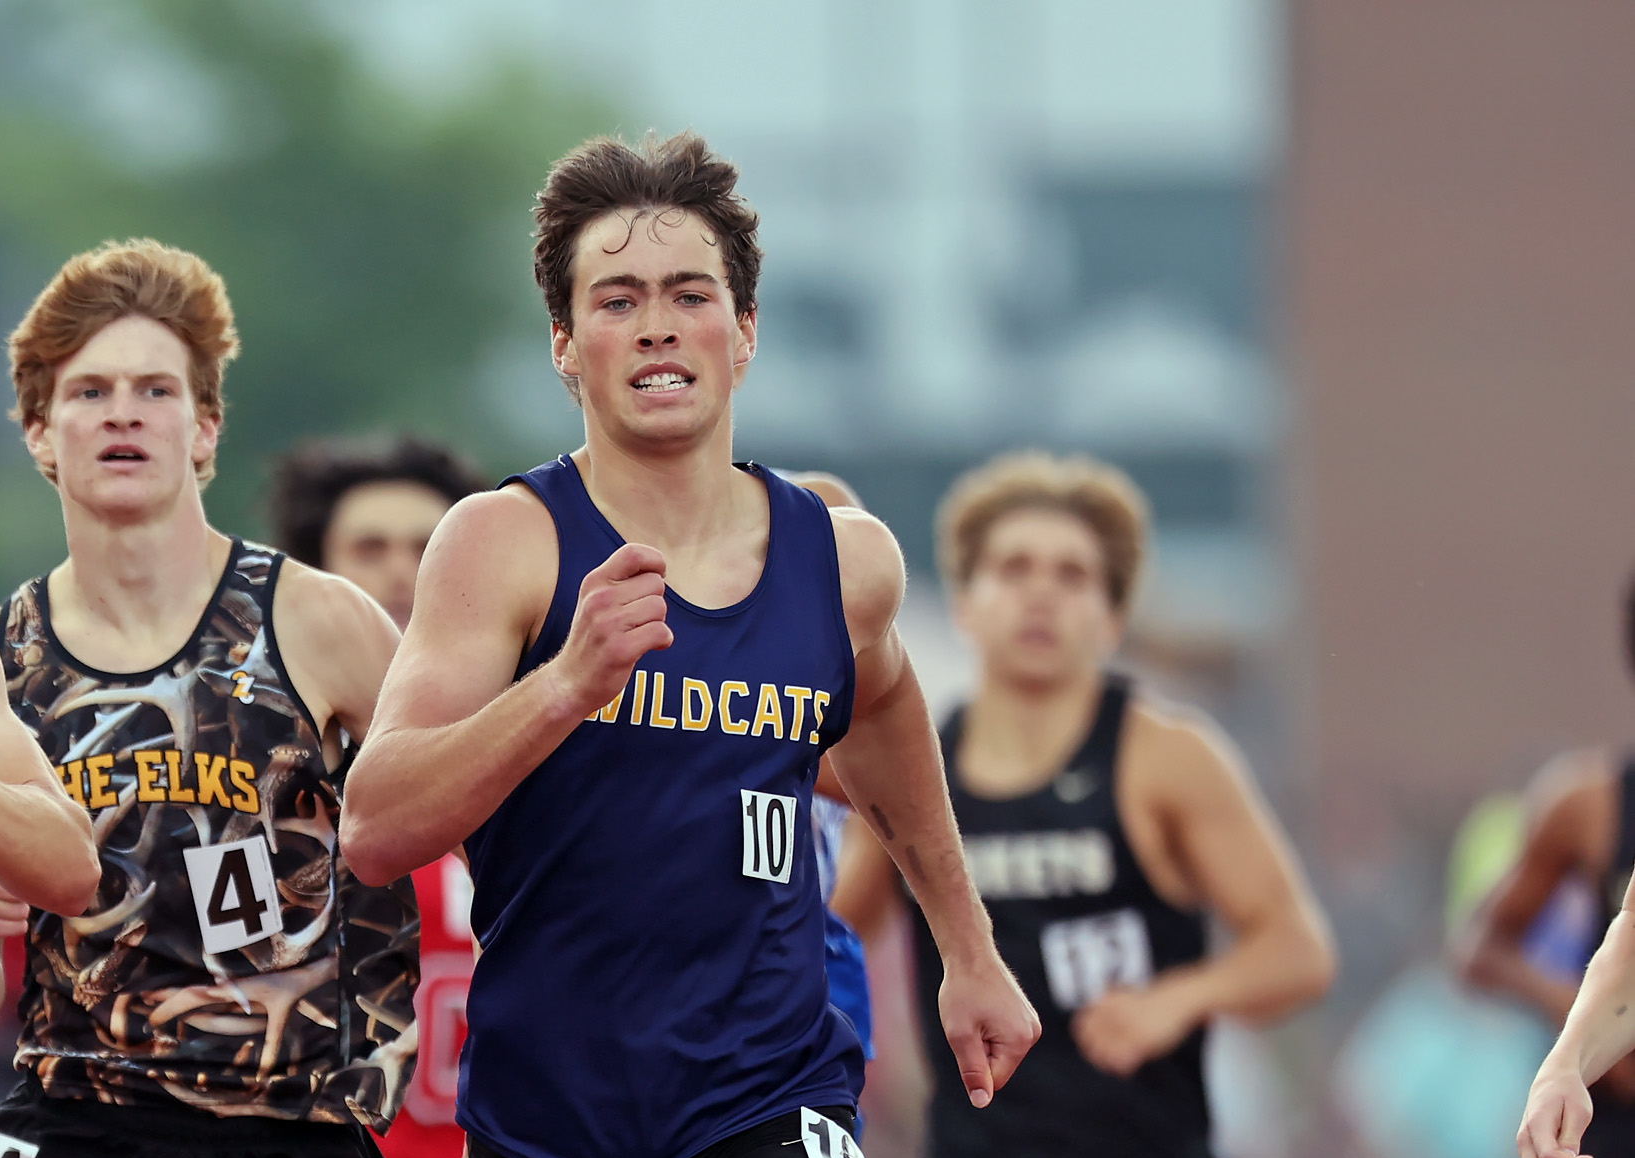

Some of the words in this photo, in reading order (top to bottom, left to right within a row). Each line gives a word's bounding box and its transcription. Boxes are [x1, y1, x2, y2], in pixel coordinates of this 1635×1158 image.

[54, 752, 119, 811] HE
[133, 750, 261, 815] ELKS
[746, 794, 787, 878] 10
[206, 848, 268, 938] 4
